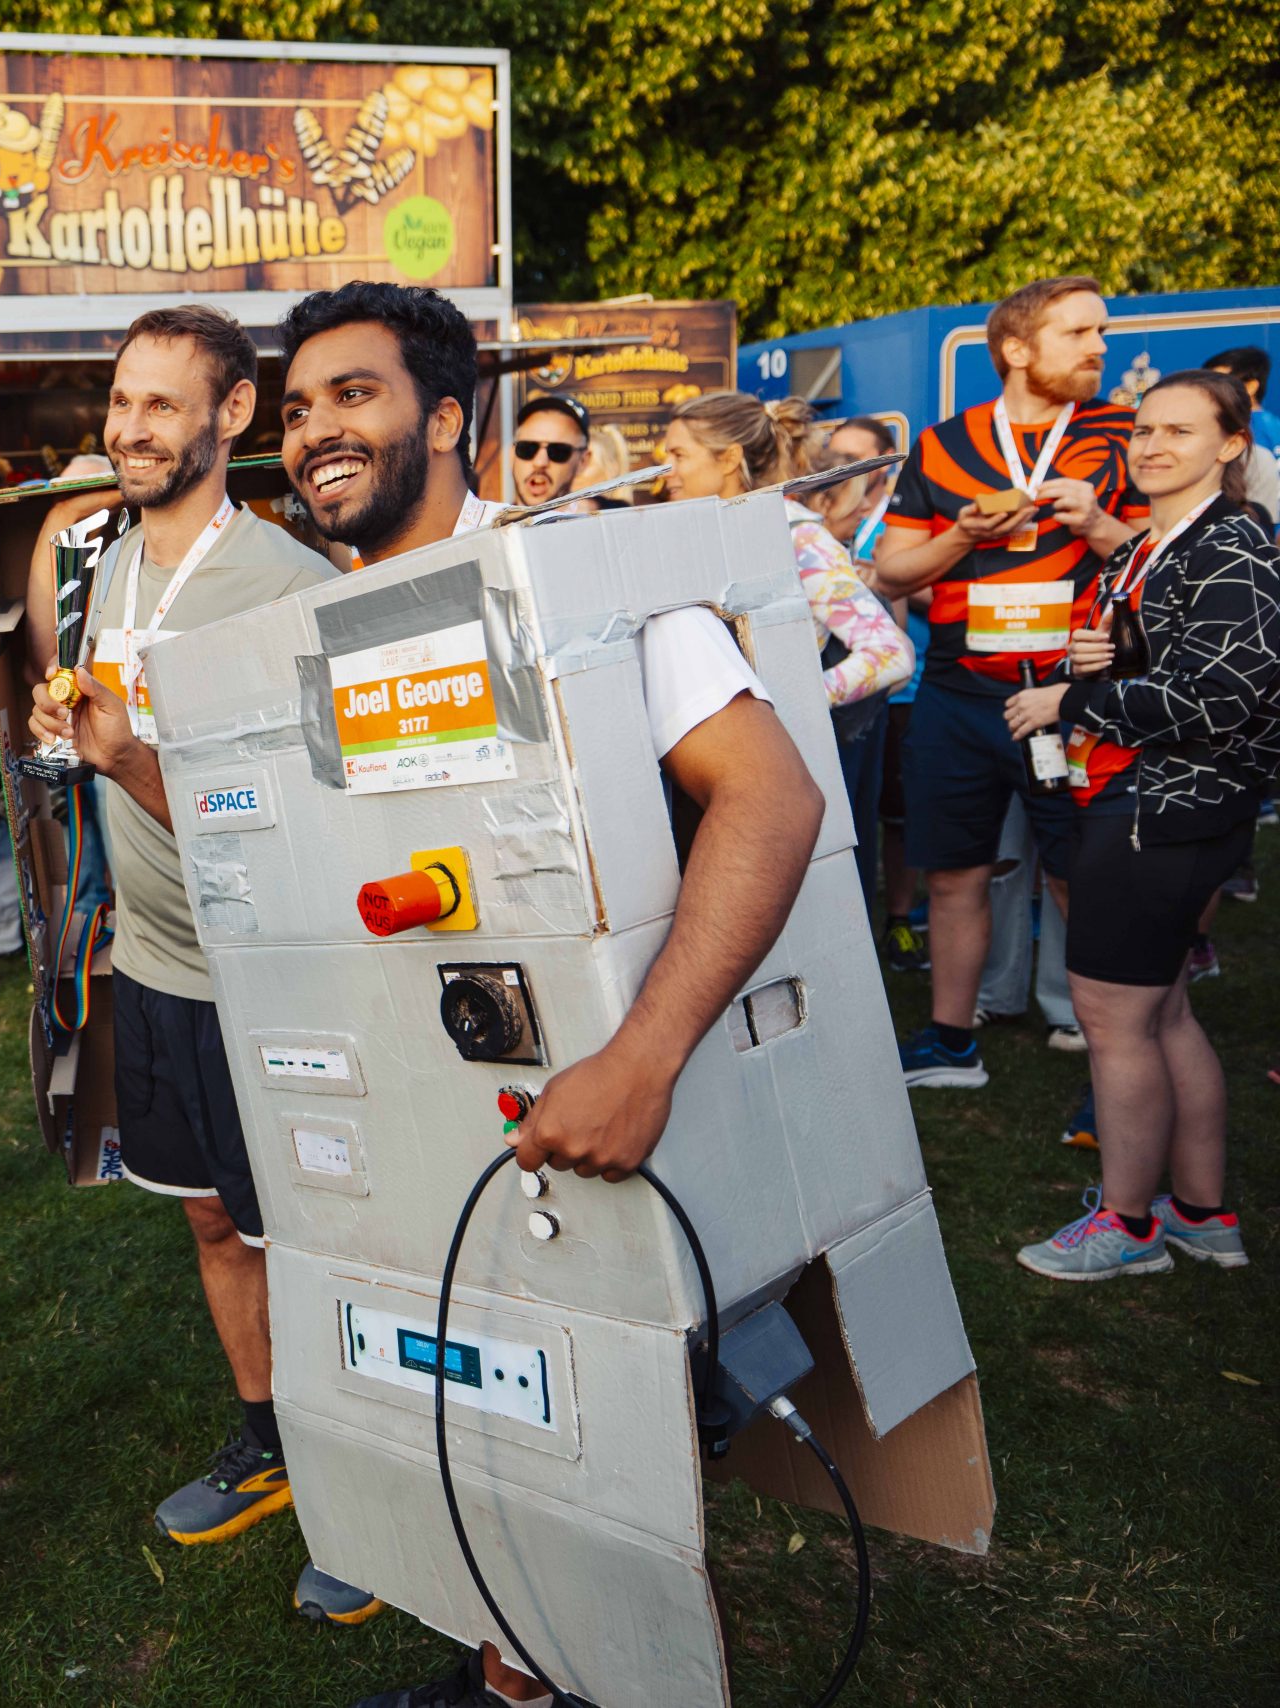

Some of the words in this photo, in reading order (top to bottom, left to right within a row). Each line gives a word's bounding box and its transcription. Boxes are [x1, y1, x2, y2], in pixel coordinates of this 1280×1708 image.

[7, 173, 347, 273] Kartoffelhütte
[394, 224, 446, 261] Vegan
[756, 348, 787, 380] 10
[573, 391, 621, 408] OADED
[994, 605, 1041, 620] Robin
[343, 682, 391, 718] Joel
[396, 672, 485, 707] George
[398, 716, 429, 734] 3177
[358, 762, 388, 774] Kaufland
[396, 756, 418, 769] AOK
[199, 790, 258, 813] dSPACE
[363, 891, 390, 909] NOT
[365, 911, 392, 931] AUS
